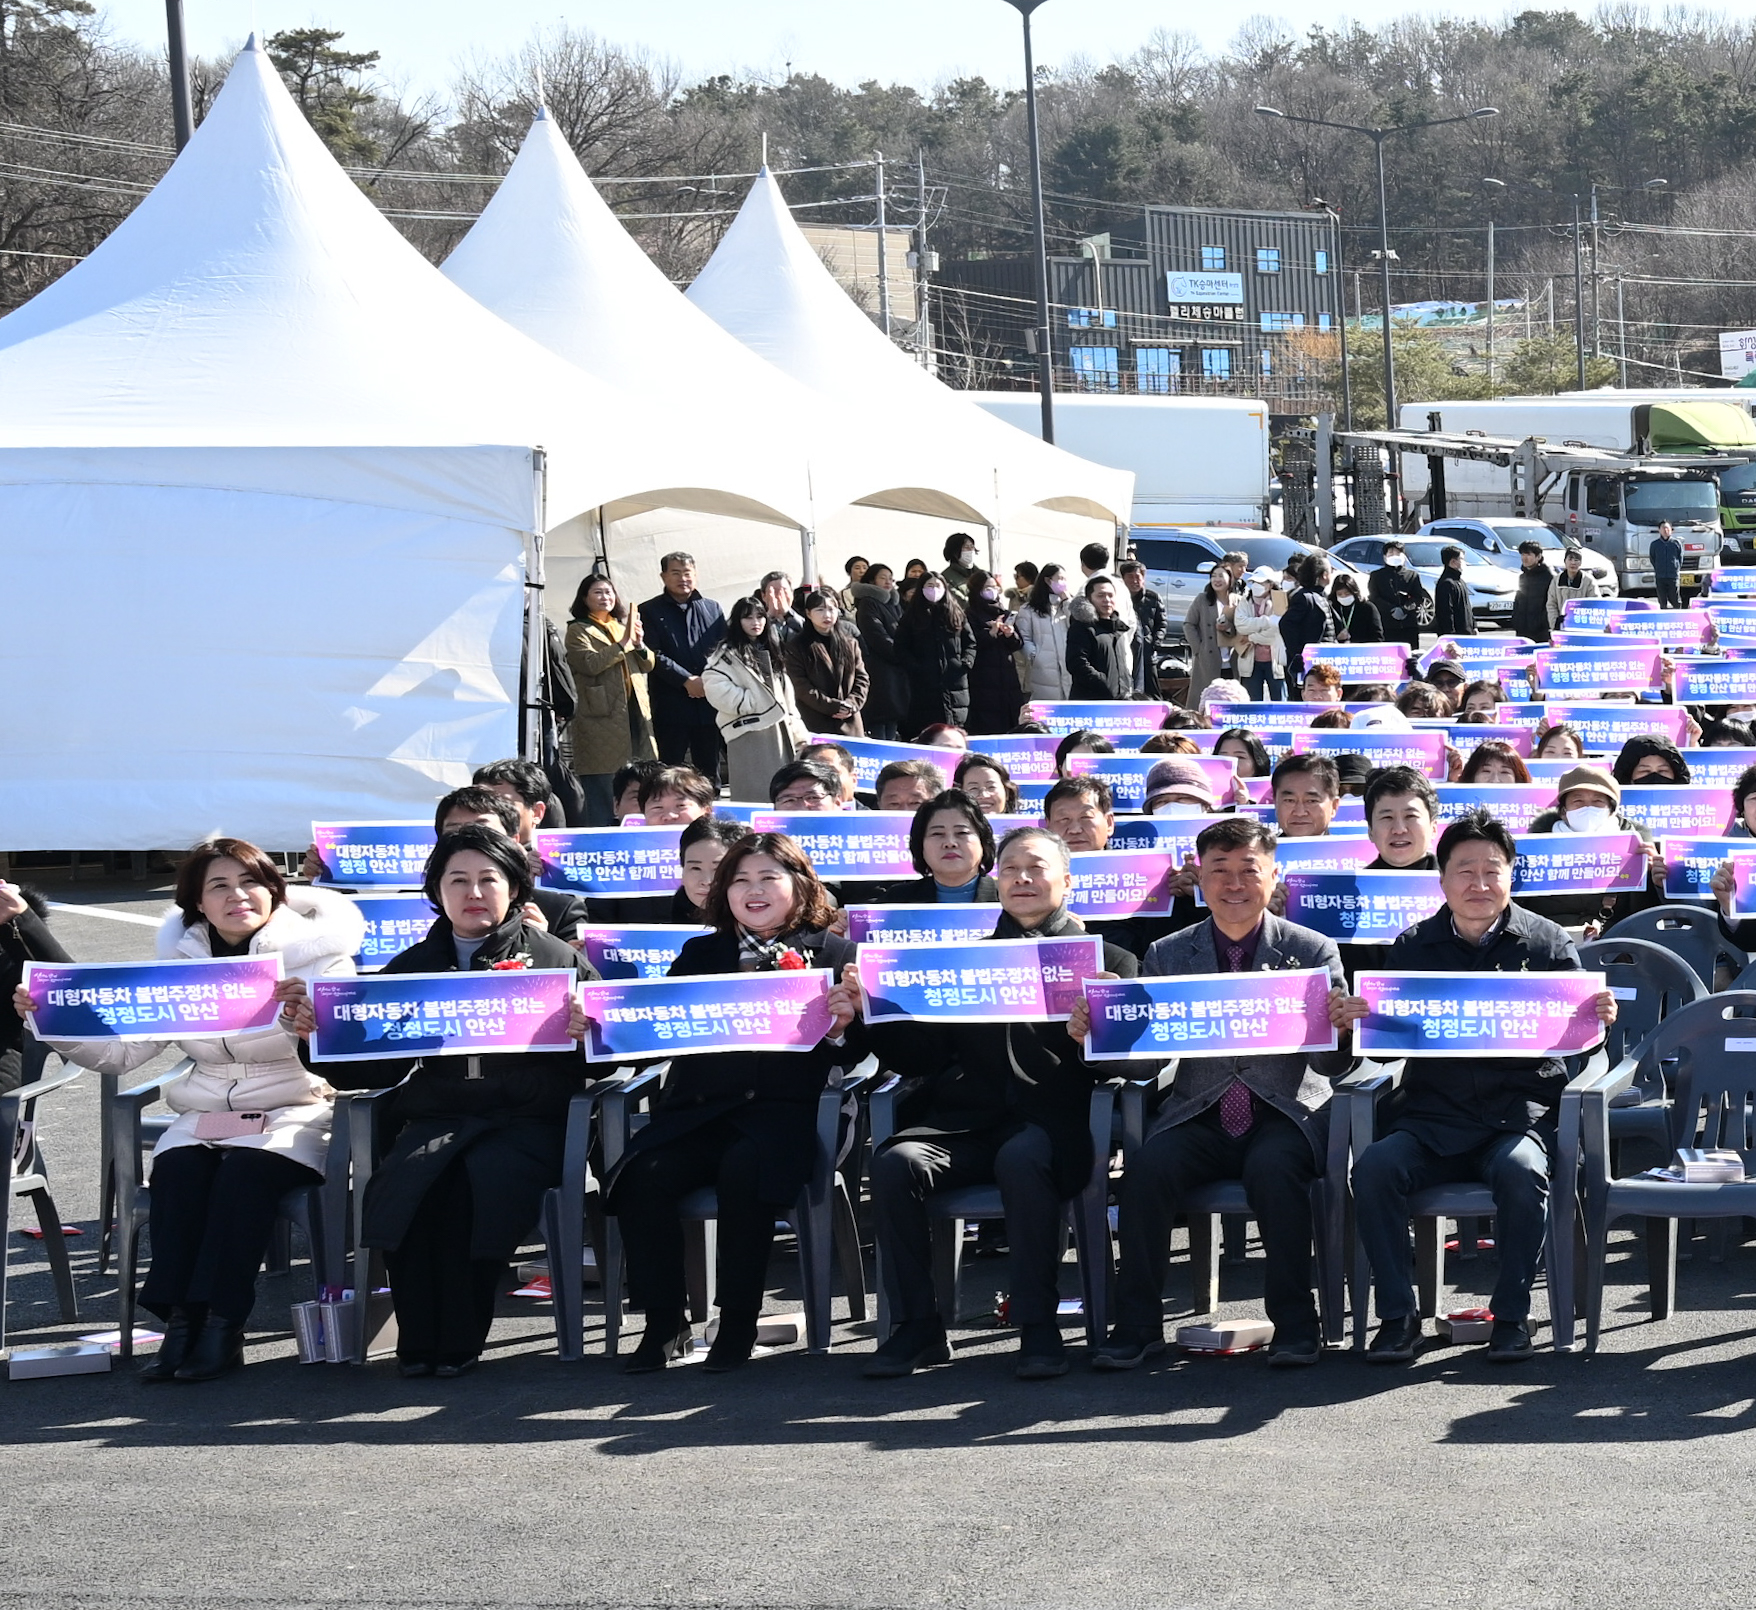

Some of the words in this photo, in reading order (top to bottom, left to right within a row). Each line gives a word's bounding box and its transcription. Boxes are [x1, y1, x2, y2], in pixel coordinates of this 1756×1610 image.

[1690, 683, 1707, 694] 청정
[1709, 681, 1728, 694] 안산
[1727, 684, 1746, 694] 함께
[1069, 874, 1119, 888] 불법주차
[1118, 872, 1147, 888] 없는
[1520, 868, 1545, 883] 안산
[1547, 868, 1569, 881] 함께
[1572, 866, 1622, 879] 만들어요!
[1091, 889, 1150, 903] 만들어요!
[1301, 895, 1370, 909] 대형자동차
[1340, 912, 1402, 928] 청정도시
[878, 969, 957, 987] 대형자동차
[960, 967, 1038, 985] 불법주정차
[1042, 966, 1074, 982] 없는
[48, 987, 131, 1007] 대형자동차
[135, 984, 219, 1004] 불법주정차
[222, 982, 256, 999] 없는
[924, 988, 997, 1006] 청정도시
[1000, 986, 1037, 1005] 안산
[96, 1005, 176, 1025] 청정도시
[178, 1002, 219, 1021] 안산
[334, 1002, 419, 1021] 대형자동차
[423, 998, 508, 1017] 불법주정차
[511, 997, 546, 1015] 없는
[603, 1005, 686, 1023] 대형자동차
[689, 1001, 771, 1019] 불법주정차
[774, 999, 809, 1016] 없는
[1105, 1002, 1187, 1022] 대형자동차
[1190, 998, 1271, 1018] 불법주정차
[1274, 997, 1307, 1014] 없는
[1378, 1000, 1459, 1016] 대형자동차
[1462, 1000, 1542, 1017] 불법주정차
[1544, 1001, 1579, 1017] 없는
[382, 1019, 462, 1041] 청정도시
[466, 1017, 506, 1036] 안산
[653, 1019, 730, 1039] 청정도시
[732, 1017, 772, 1036] 안산
[1151, 1020, 1225, 1041] 청정도시
[1230, 1018, 1268, 1038] 안산
[1422, 1019, 1496, 1038] 청정도시
[1501, 1019, 1539, 1038] 안산
